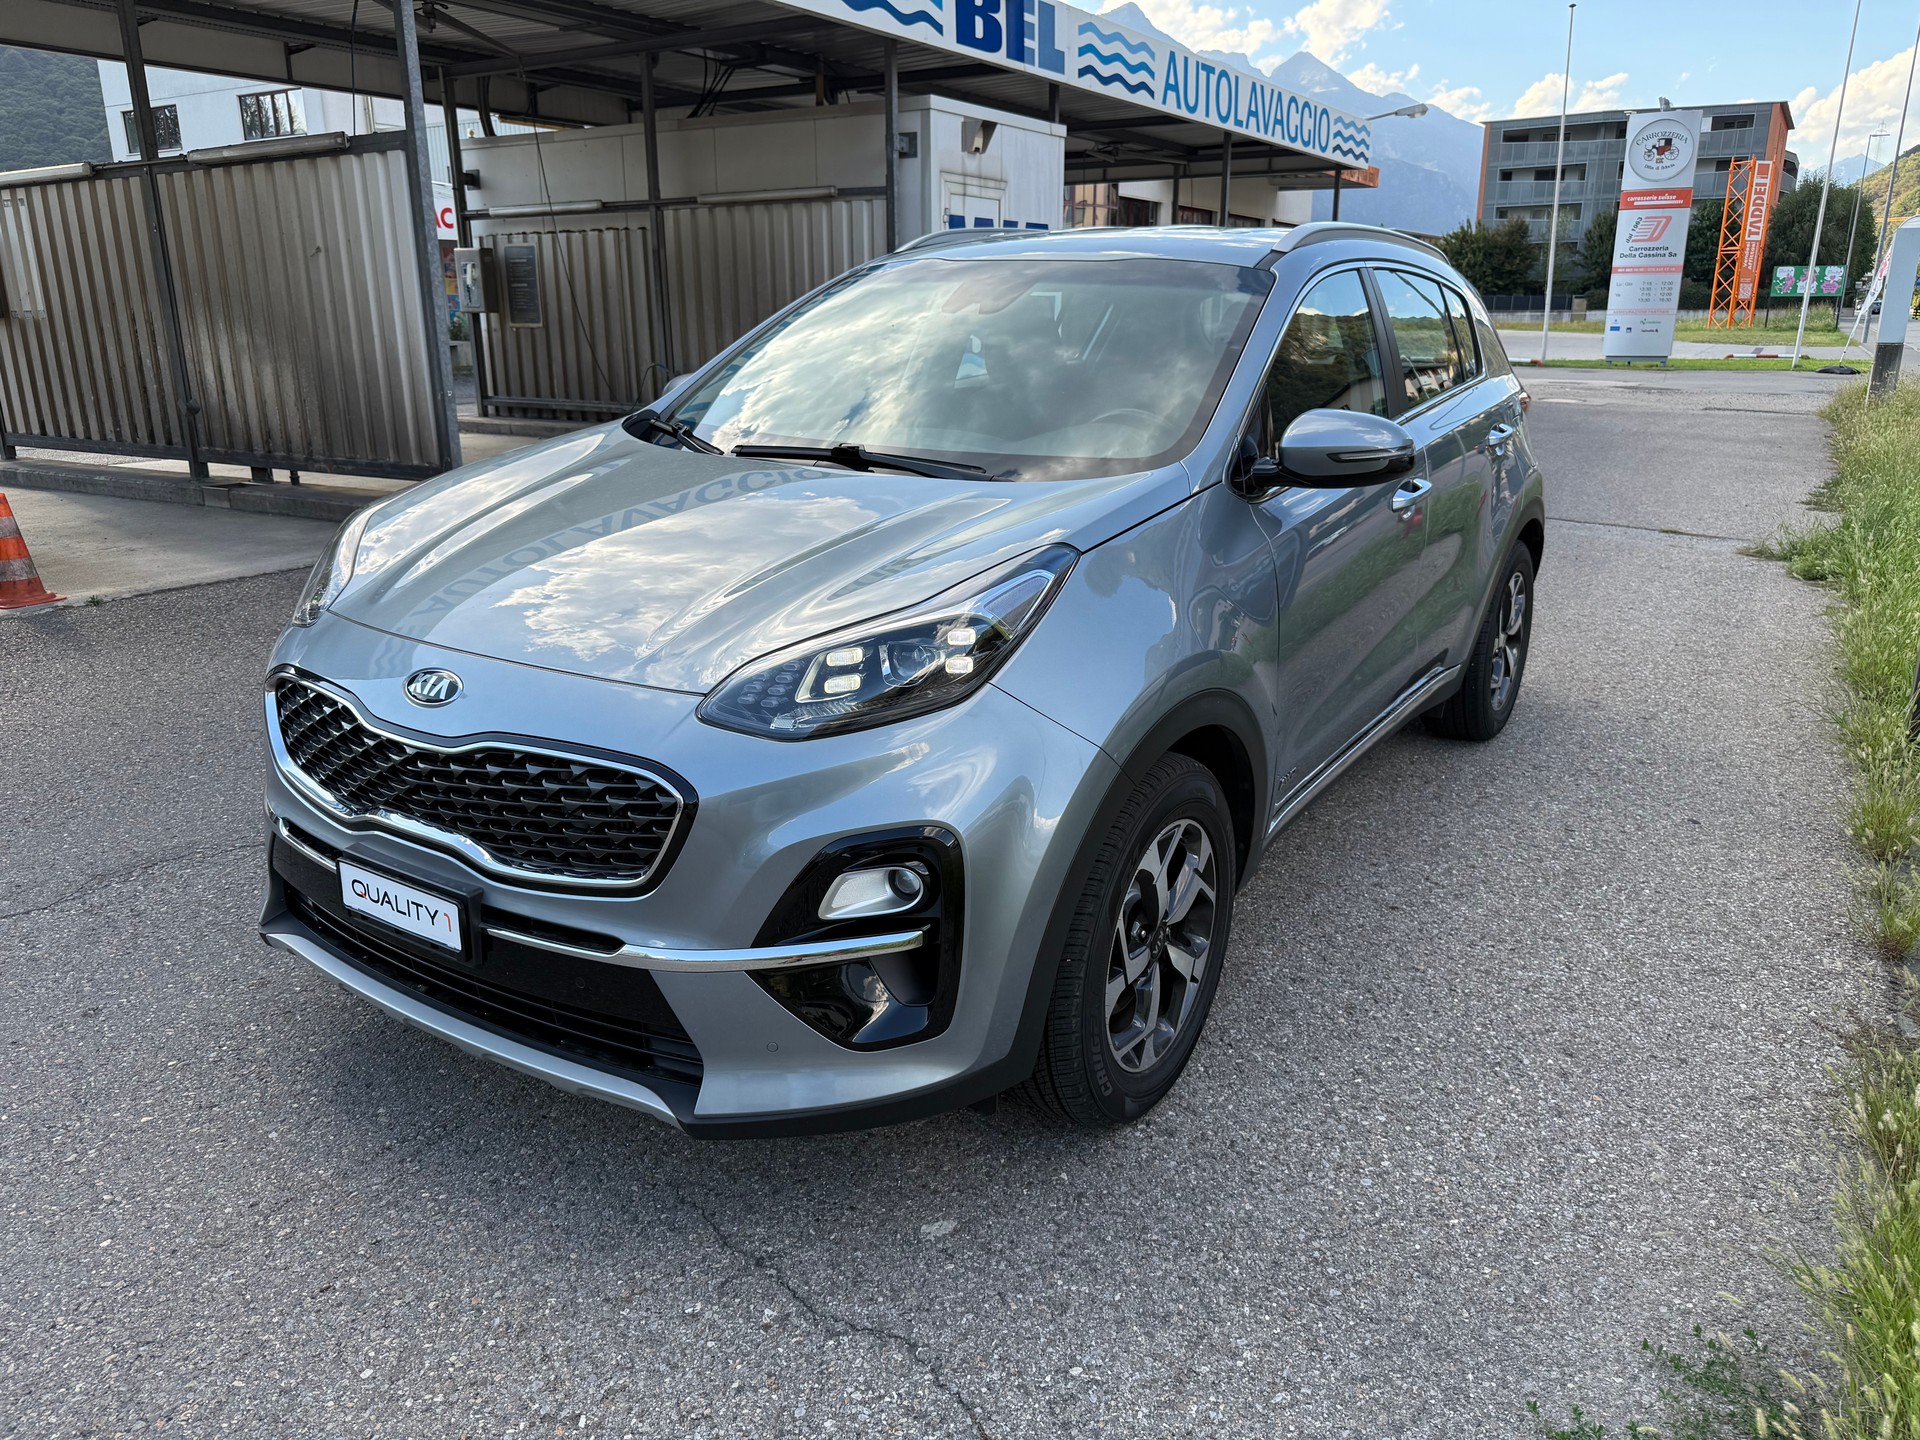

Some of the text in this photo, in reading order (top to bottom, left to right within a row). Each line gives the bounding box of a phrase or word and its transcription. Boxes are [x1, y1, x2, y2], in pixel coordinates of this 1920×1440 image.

[956, 0, 1065, 75] BEL
[1162, 50, 1331, 153] AUTOLAVAGGIO
[1636, 131, 1688, 145] CARROZZERIA
[1747, 182, 1767, 238] TADDEI
[1625, 233, 1634, 243] dal
[408, 673, 450, 700] KIA
[351, 879, 439, 926] QUALITY
